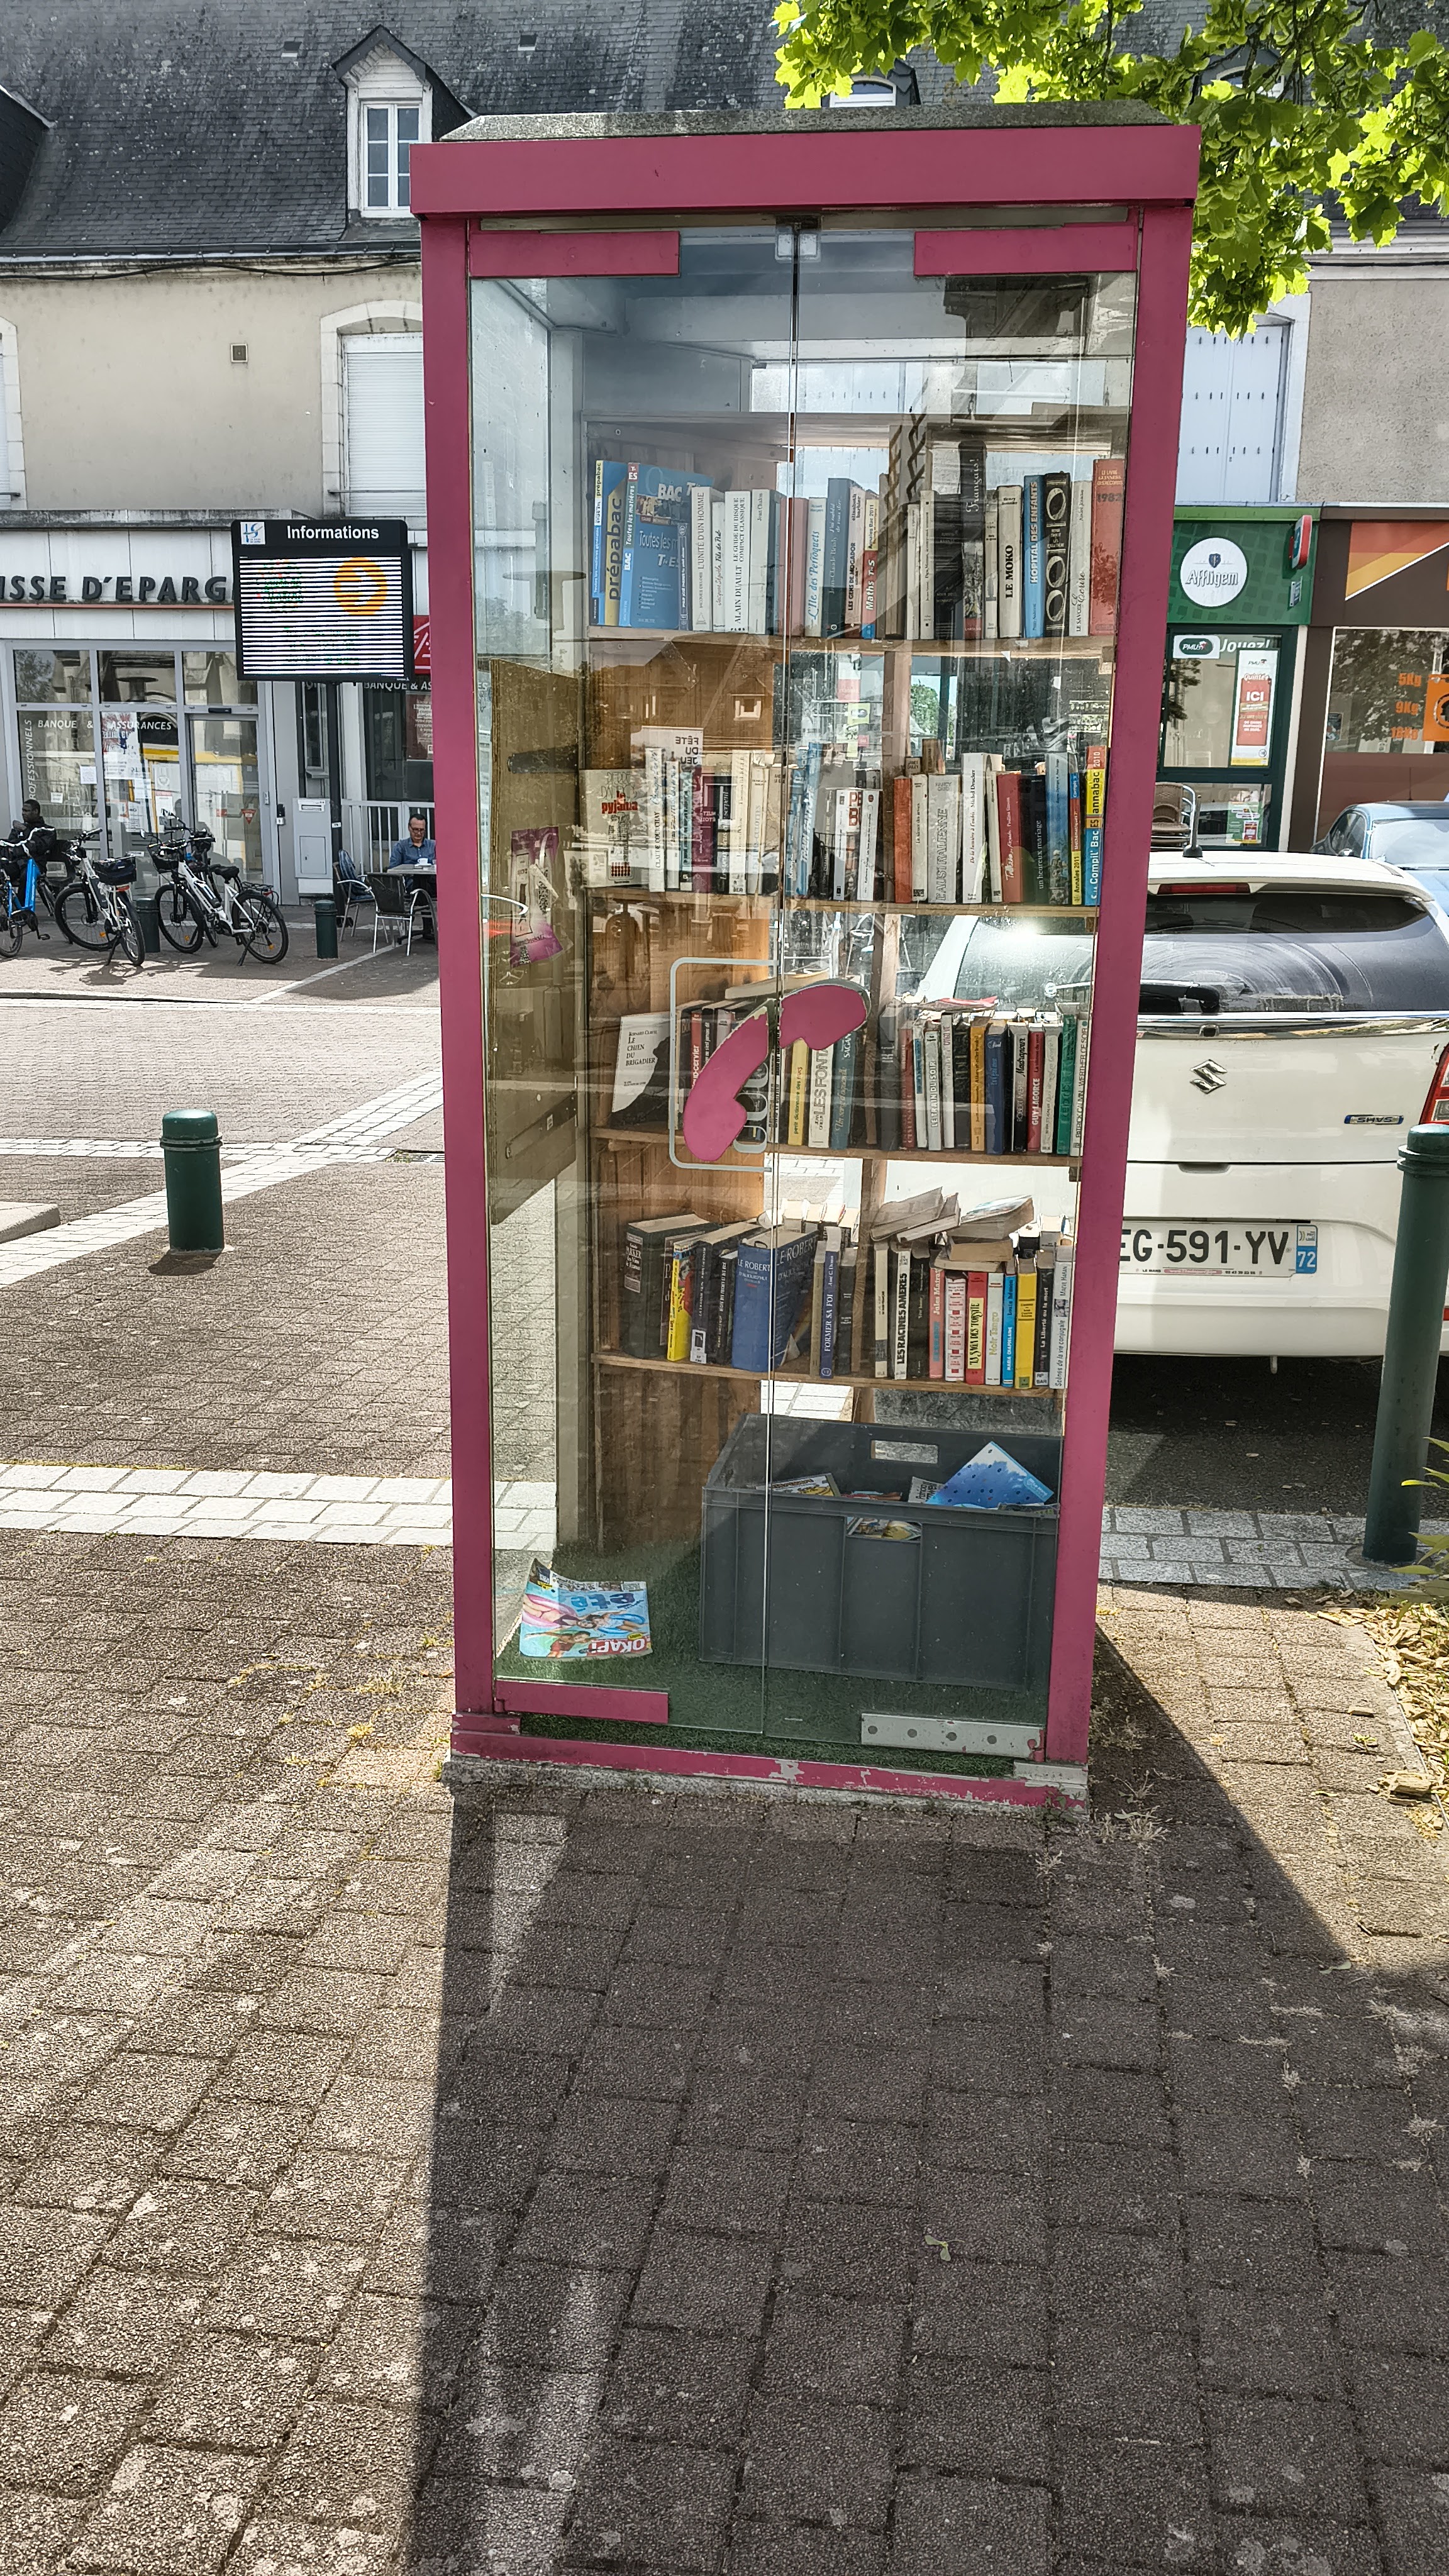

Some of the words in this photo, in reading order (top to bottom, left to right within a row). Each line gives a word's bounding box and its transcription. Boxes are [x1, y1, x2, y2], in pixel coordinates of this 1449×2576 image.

[658, 483, 682, 502] BAC
[697, 492, 705, 521] HOMME
[1030, 481, 1038, 523] ENFANTS
[287, 525, 379, 540] Informations
[639, 530, 660, 548] Toutes
[660, 532, 672, 549] les
[1030, 523, 1038, 541] DES
[607, 498, 623, 601] prépabac
[695, 541, 705, 569] L'UNITÉ
[624, 553, 632, 571] BAC
[1004, 545, 1013, 580] MOKO
[1030, 543, 1038, 584] HOPITAL
[1185, 569, 1239, 587] Affligem
[82, 576, 233, 602] D'EPARG
[865, 580, 874, 611] Maths
[1004, 584, 1013, 598] LE
[1182, 643, 1201, 651] PMU
[364, 681, 408, 692] BANQUE
[1398, 672, 1422, 687] 5Kg
[1246, 691, 1265, 702] ICI
[1395, 700, 1419, 715] 9Kg
[38, 719, 77, 730] BANQUE
[86, 720, 94, 729] &
[111, 721, 172, 730] ASSURANCES
[25, 719, 37, 800] ROFESSIONNELS
[1091, 772, 1100, 814] annabac
[601, 800, 638, 814] pyjama
[1090, 819, 1099, 828] ES
[1035, 819, 1043, 849] mariage
[1090, 830, 1099, 848] Bac
[1036, 850, 1044, 879] heureux
[1090, 850, 1100, 884] Compil'
[1038, 879, 1045, 889] un
[843, 1033, 852, 1058] SAGAN
[626, 1058, 655, 1067] BRIGADIER
[1014, 1037, 1027, 1077] Madrapour
[930, 1081, 937, 1092] DU
[1032, 1077, 1040, 1109] LAGORCE
[813, 1089, 827, 1115] LES
[930, 1118, 938, 1128] LE
[1031, 1110, 1040, 1126] GUY
[786, 1235, 818, 1262] ROBERT
[1119, 1228, 1289, 1265] EG-591-YV
[738, 1258, 743, 1267] LE
[745, 1260, 770, 1272] ROBERT
[1297, 1250, 1316, 1268] 72
[825, 1309, 833, 1319] SA
[897, 1309, 907, 1348] RACINES
[989, 1311, 999, 1336] Tango
[1057, 1319, 1065, 1345] conjugale
[824, 1321, 832, 1352] FORMER
[970, 1328, 979, 1339] DES
[969, 1340, 981, 1357] SAGA
[989, 1338, 998, 1356] Noir
[896, 1348, 906, 1365] LES
[1055, 1367, 1063, 1387] Scènes
